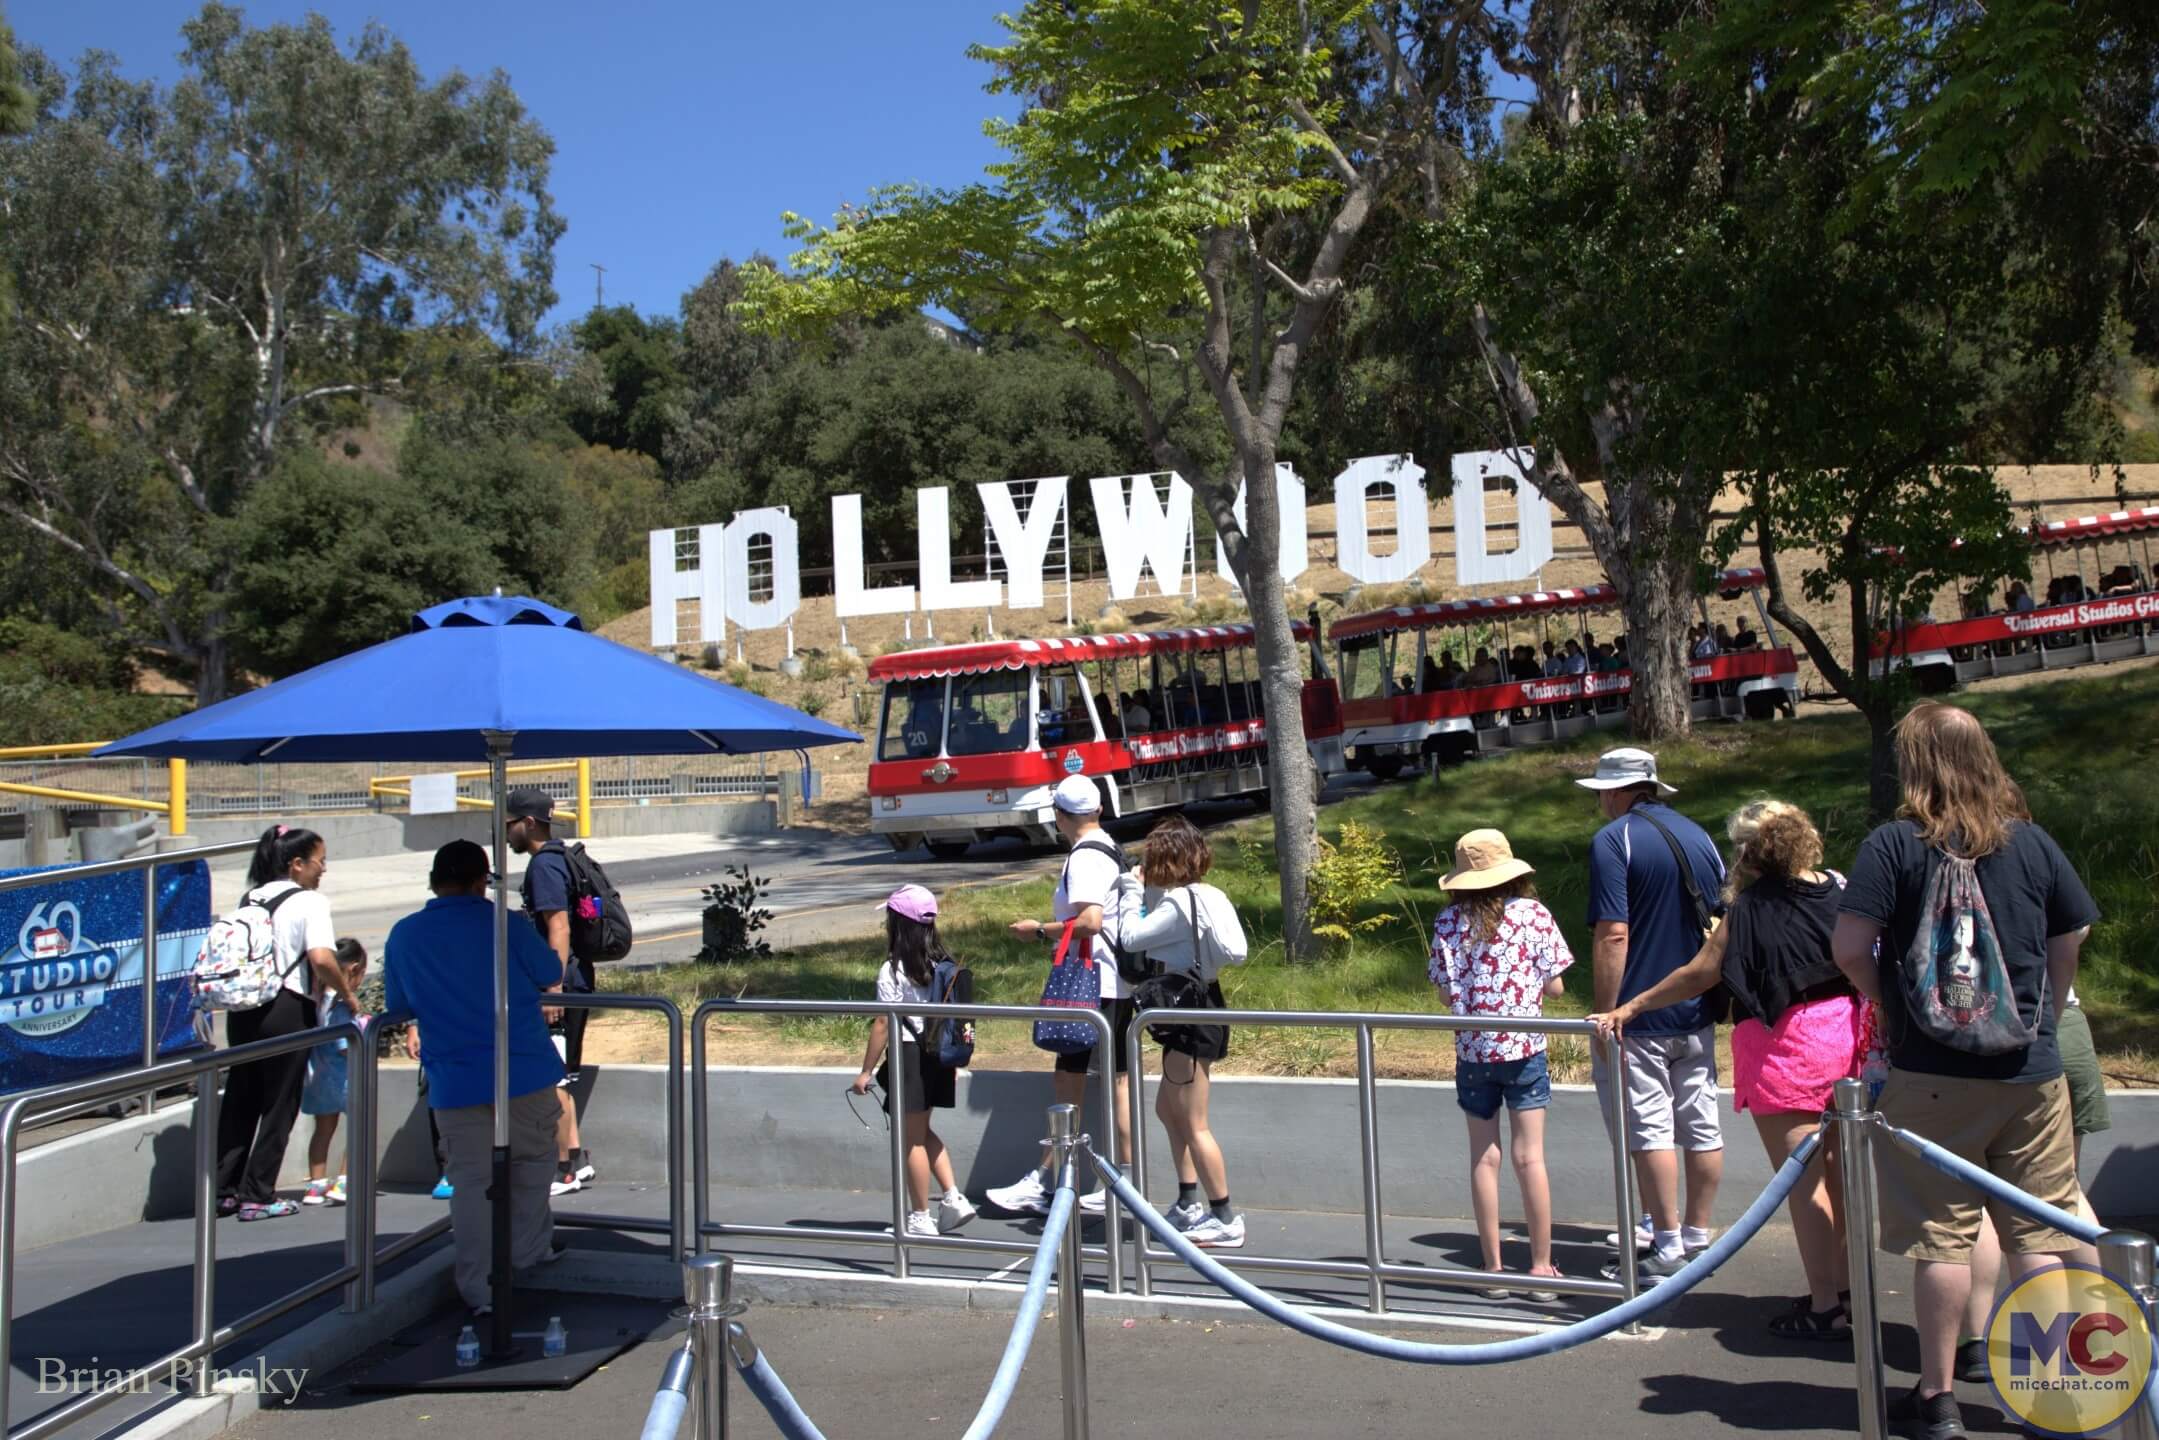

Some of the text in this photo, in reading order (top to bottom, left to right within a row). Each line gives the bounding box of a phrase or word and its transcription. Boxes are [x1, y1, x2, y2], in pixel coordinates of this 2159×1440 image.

[2004, 608, 2075, 632] Universal
[2078, 602, 2133, 624] Studios
[1521, 664, 1713, 700] Universal Studios ram
[908, 731, 928, 746] 20
[1130, 735, 1179, 760] Universal
[1248, 722, 1267, 743] Tra
[19, 900, 80, 959] 60
[13, 990, 85, 1018] TOUR
[22, 1013, 77, 1032] ANNIVERSARY
